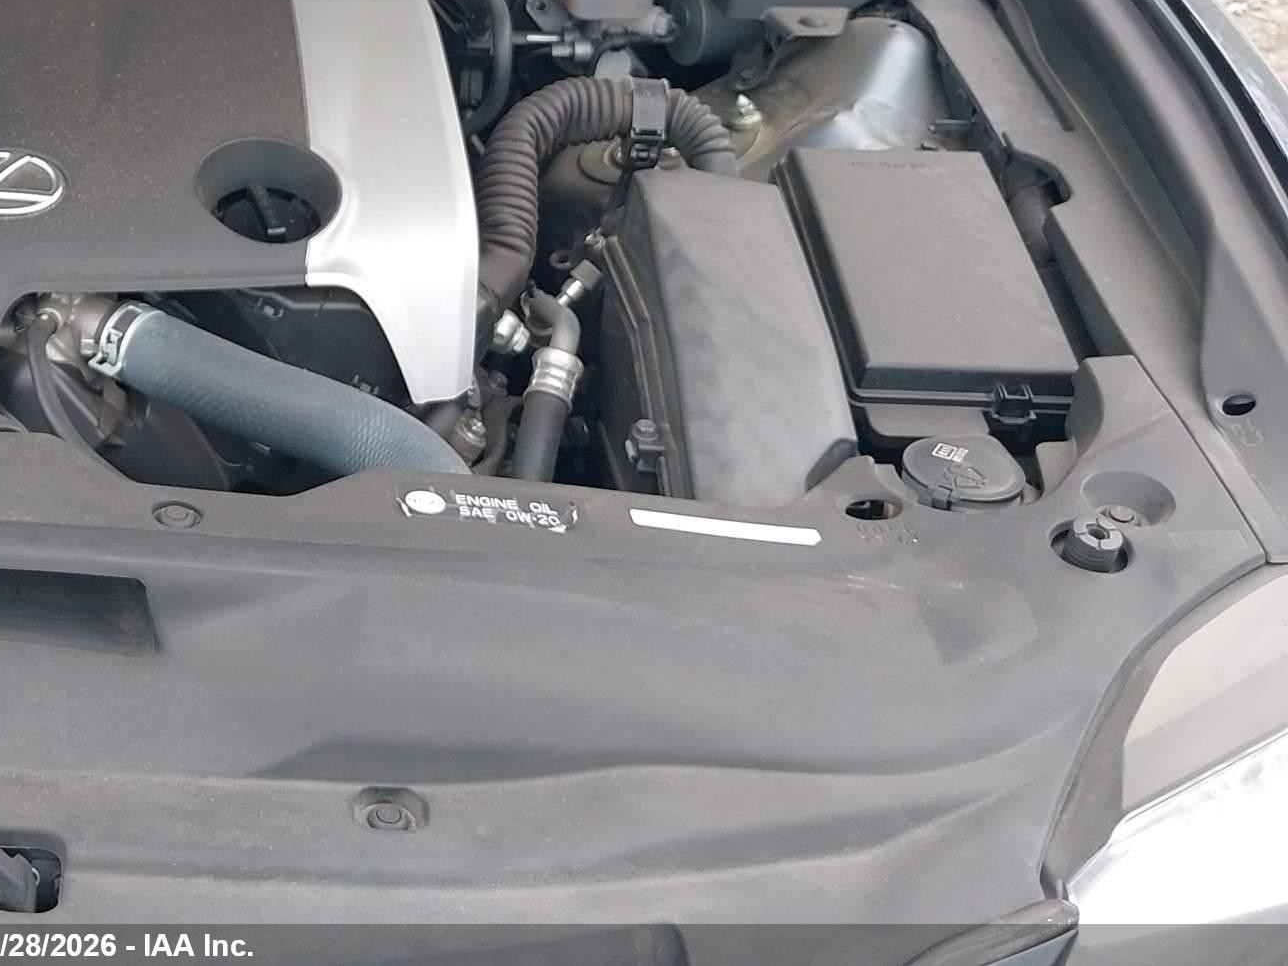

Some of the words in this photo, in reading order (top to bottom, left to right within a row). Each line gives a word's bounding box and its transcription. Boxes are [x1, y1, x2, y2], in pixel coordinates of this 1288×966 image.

[455, 494, 519, 509] ENGINE
[529, 502, 558, 515] OIL
[458, 506, 495, 519] SAE
